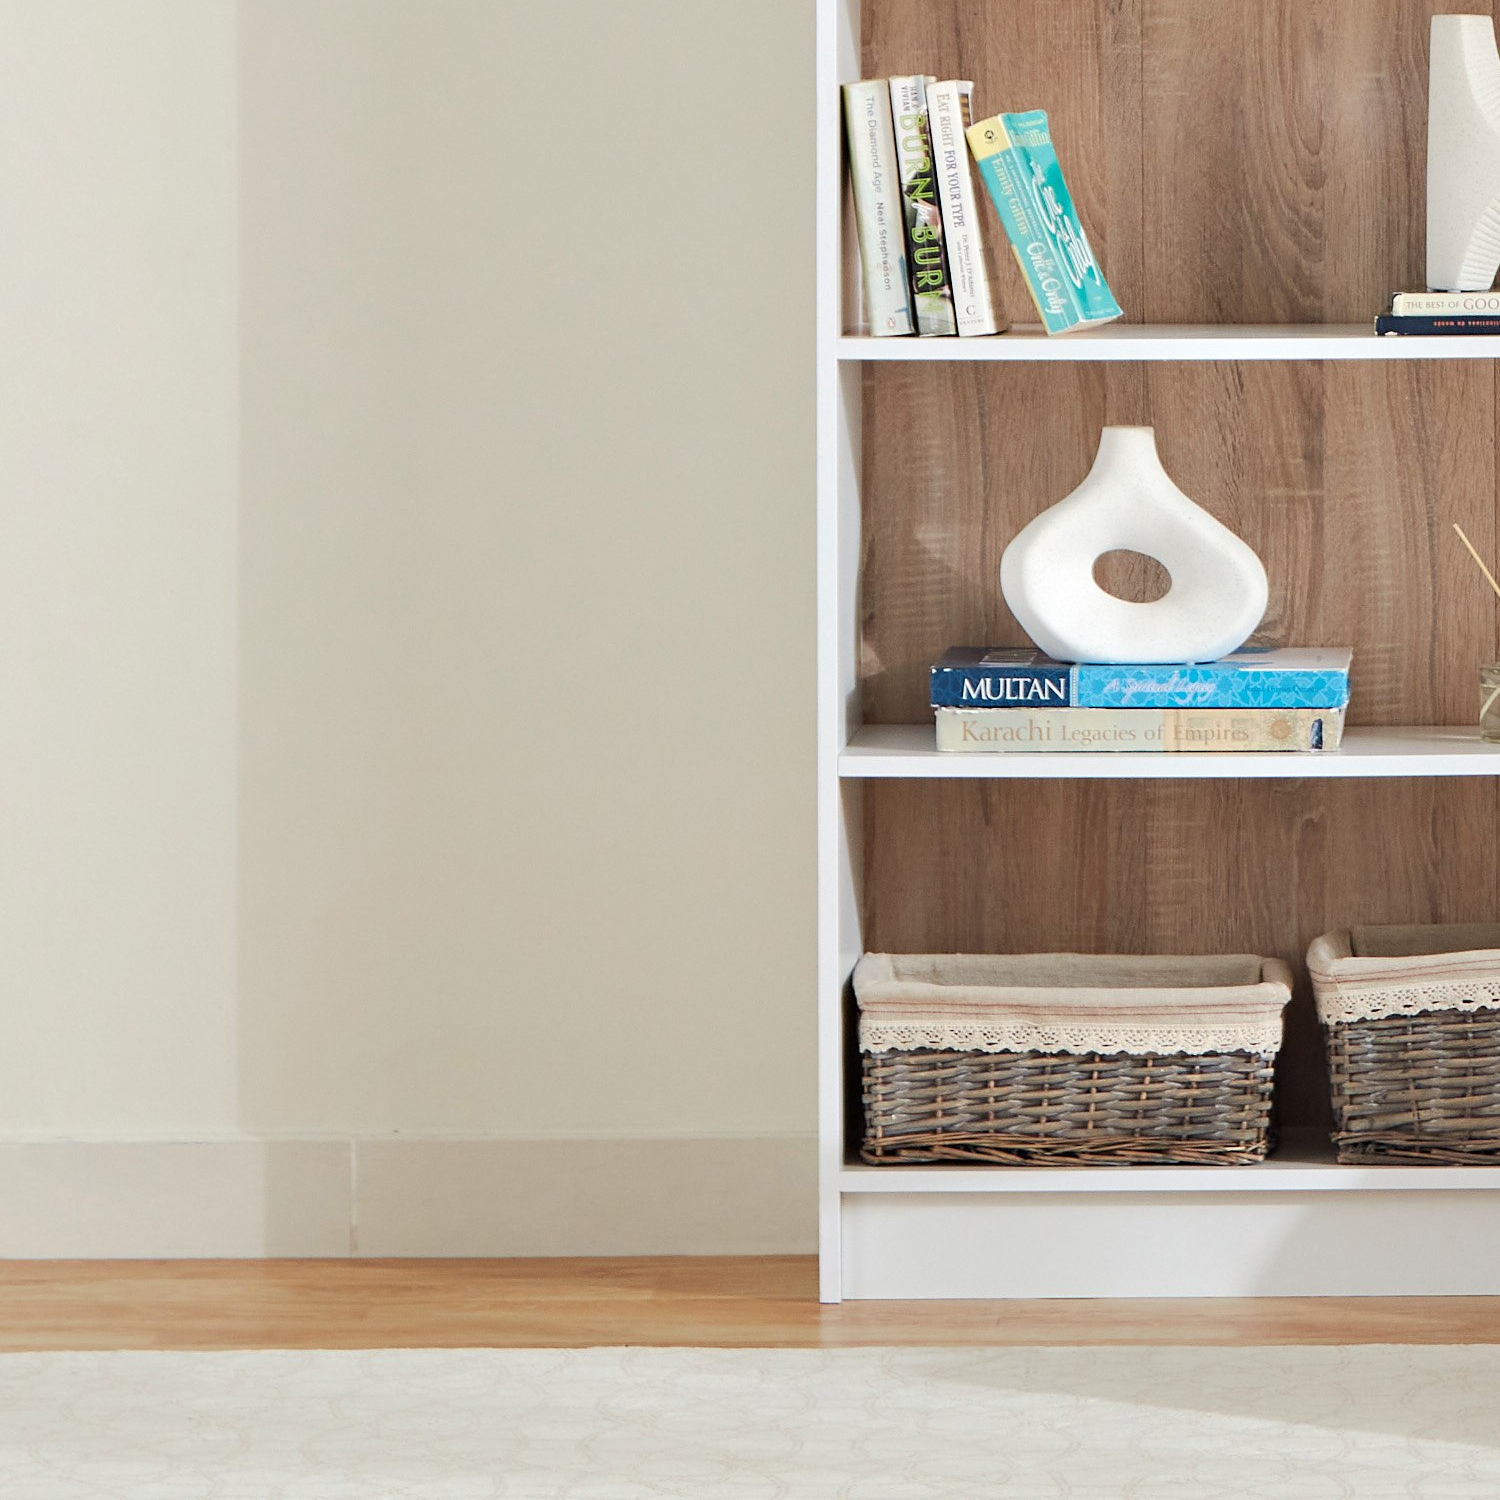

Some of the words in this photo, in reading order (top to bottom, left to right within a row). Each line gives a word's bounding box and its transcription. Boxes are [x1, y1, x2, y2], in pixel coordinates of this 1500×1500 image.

[866, 96, 874, 116] The
[901, 86, 910, 111] VIVIAN
[937, 94, 950, 113] EAT
[940, 115, 954, 146] RIGHT
[868, 119, 882, 169] Diamond
[900, 113, 933, 200] BURN
[944, 150, 957, 171] FOR
[872, 171, 882, 193] Age
[946, 171, 961, 201] YOUR
[992, 157, 1013, 196] Emily
[876, 202, 885, 226] Neal
[951, 203, 965, 228] TYPE
[911, 226, 944, 312] BURN
[1042, 277, 1066, 314] Only
[1407, 301, 1423, 309] THE
[1426, 301, 1444, 309] BEST
[1448, 301, 1460, 309] OF
[962, 678, 1066, 700] MULTAN
[962, 719, 1051, 741] Karachi
[1062, 724, 1136, 746] Legacies
[1144, 724, 1165, 741] of
[1174, 724, 1249, 745] Empires
